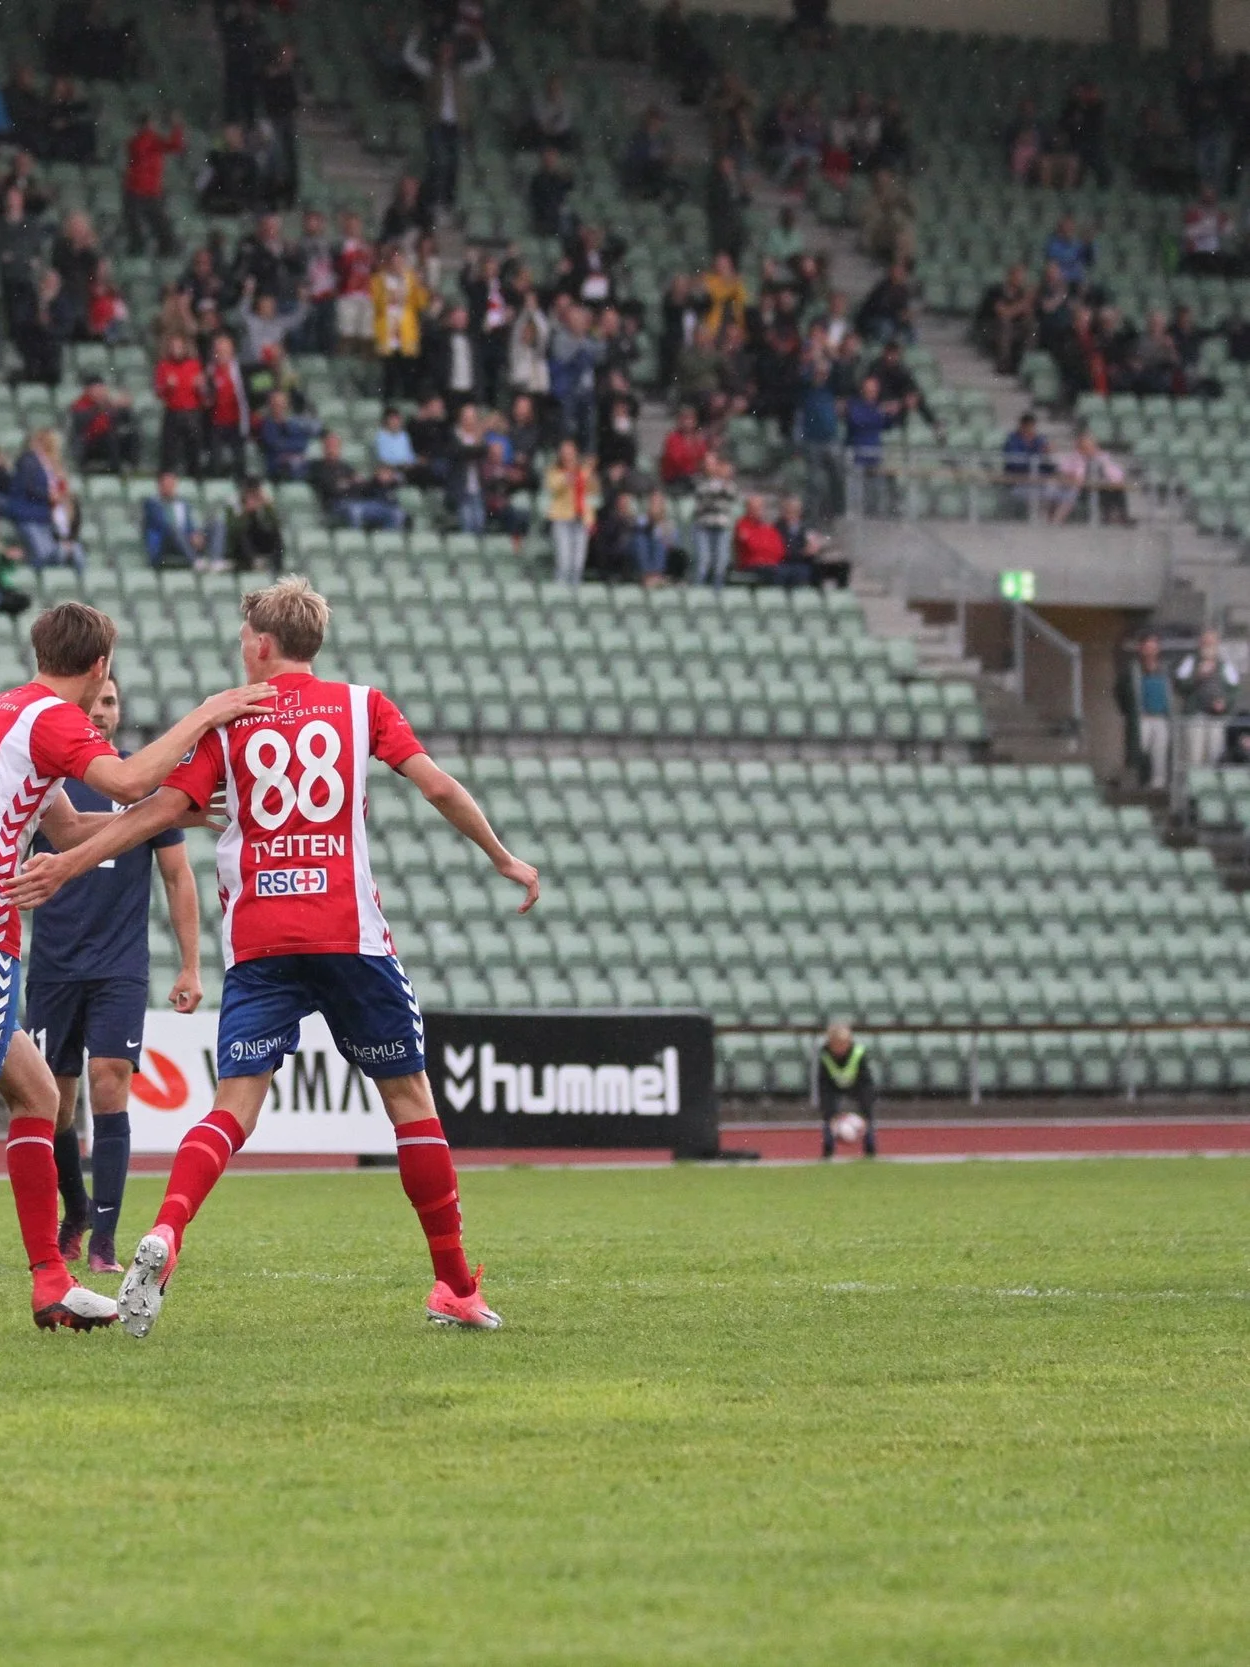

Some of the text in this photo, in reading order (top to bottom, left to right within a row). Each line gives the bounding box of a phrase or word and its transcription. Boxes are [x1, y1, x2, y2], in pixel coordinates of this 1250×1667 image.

[244, 719, 345, 831] 88
[352, 1039, 406, 1060] NEMUS
[480, 1042, 680, 1116] hummel
